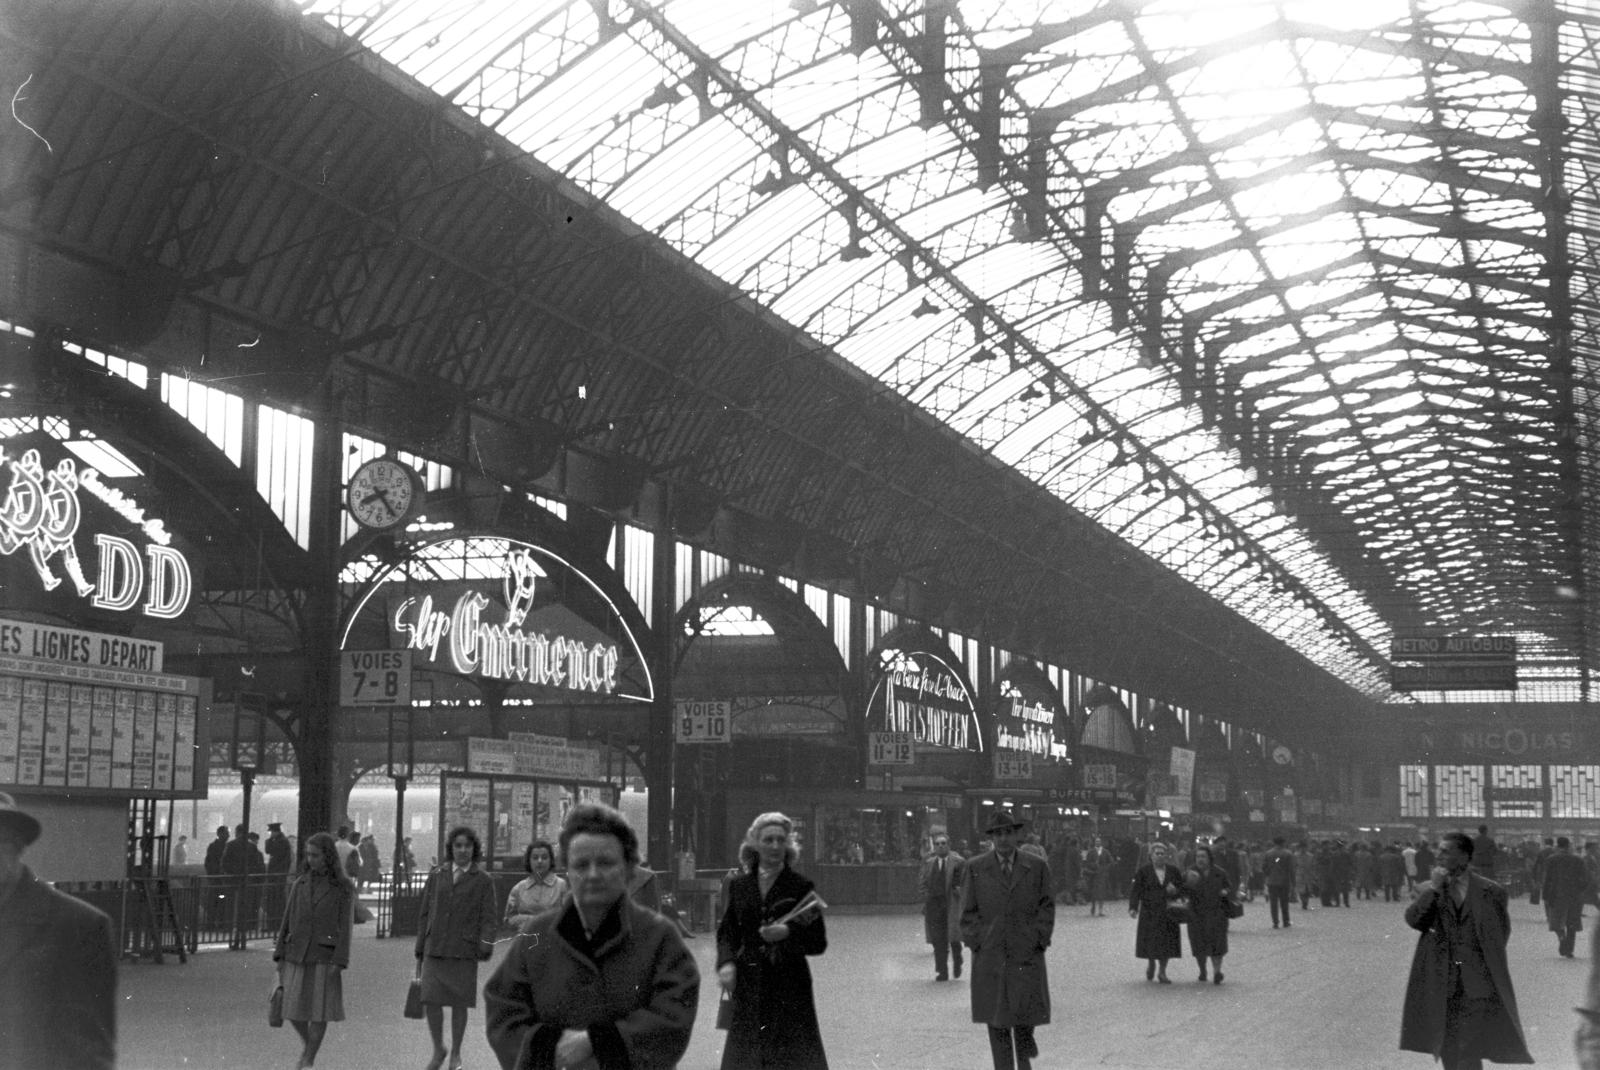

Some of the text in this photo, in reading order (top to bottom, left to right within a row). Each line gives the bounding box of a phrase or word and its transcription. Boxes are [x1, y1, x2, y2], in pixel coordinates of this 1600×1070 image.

[33, 629, 91, 664] LIGNES
[100, 638, 157, 672] DÉPART
[1445, 638, 1513, 652] AUTOBUS
[352, 652, 402, 669] VOIES
[684, 703, 724, 716] VOIES
[875, 733, 909, 744] VOIES
[1462, 729, 1573, 754] NICOLAS
[1048, 789, 1092, 800] BUFFET
